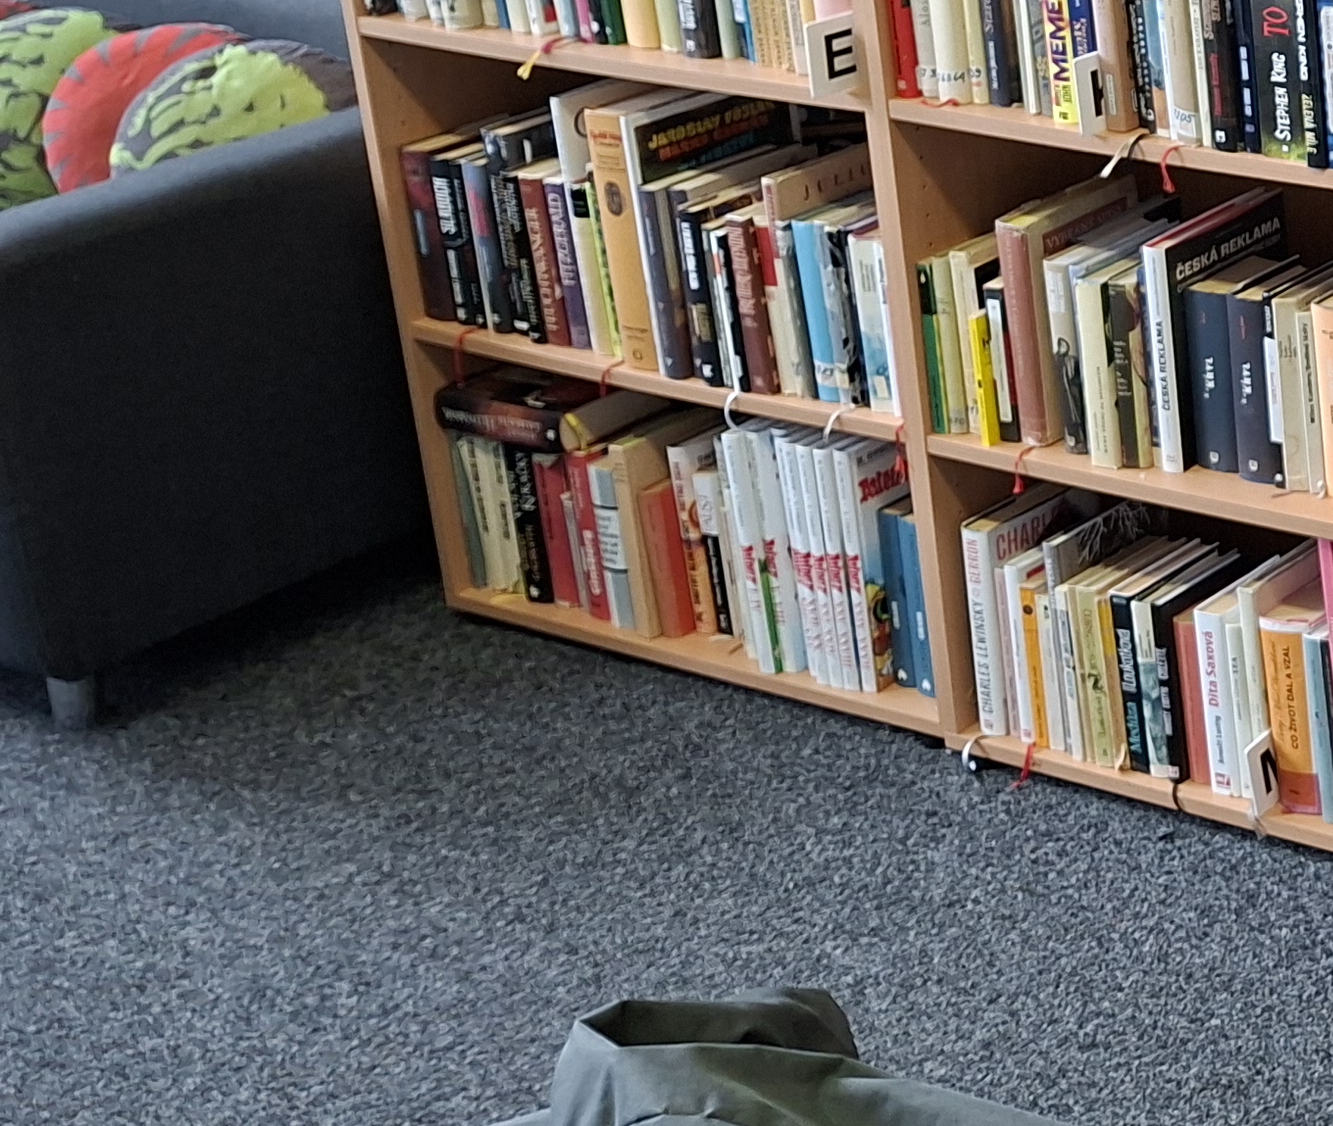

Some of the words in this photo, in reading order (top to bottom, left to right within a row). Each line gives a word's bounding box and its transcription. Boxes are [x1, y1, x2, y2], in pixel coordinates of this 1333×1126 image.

[1262, 6, 1290, 37] TO
[824, 29, 856, 80] E
[1270, 52, 1287, 83] KING
[1274, 86, 1291, 141] STEPHEN
[1155, 319, 1167, 373] REKLAMA
[1206, 679, 1220, 708] Dita
